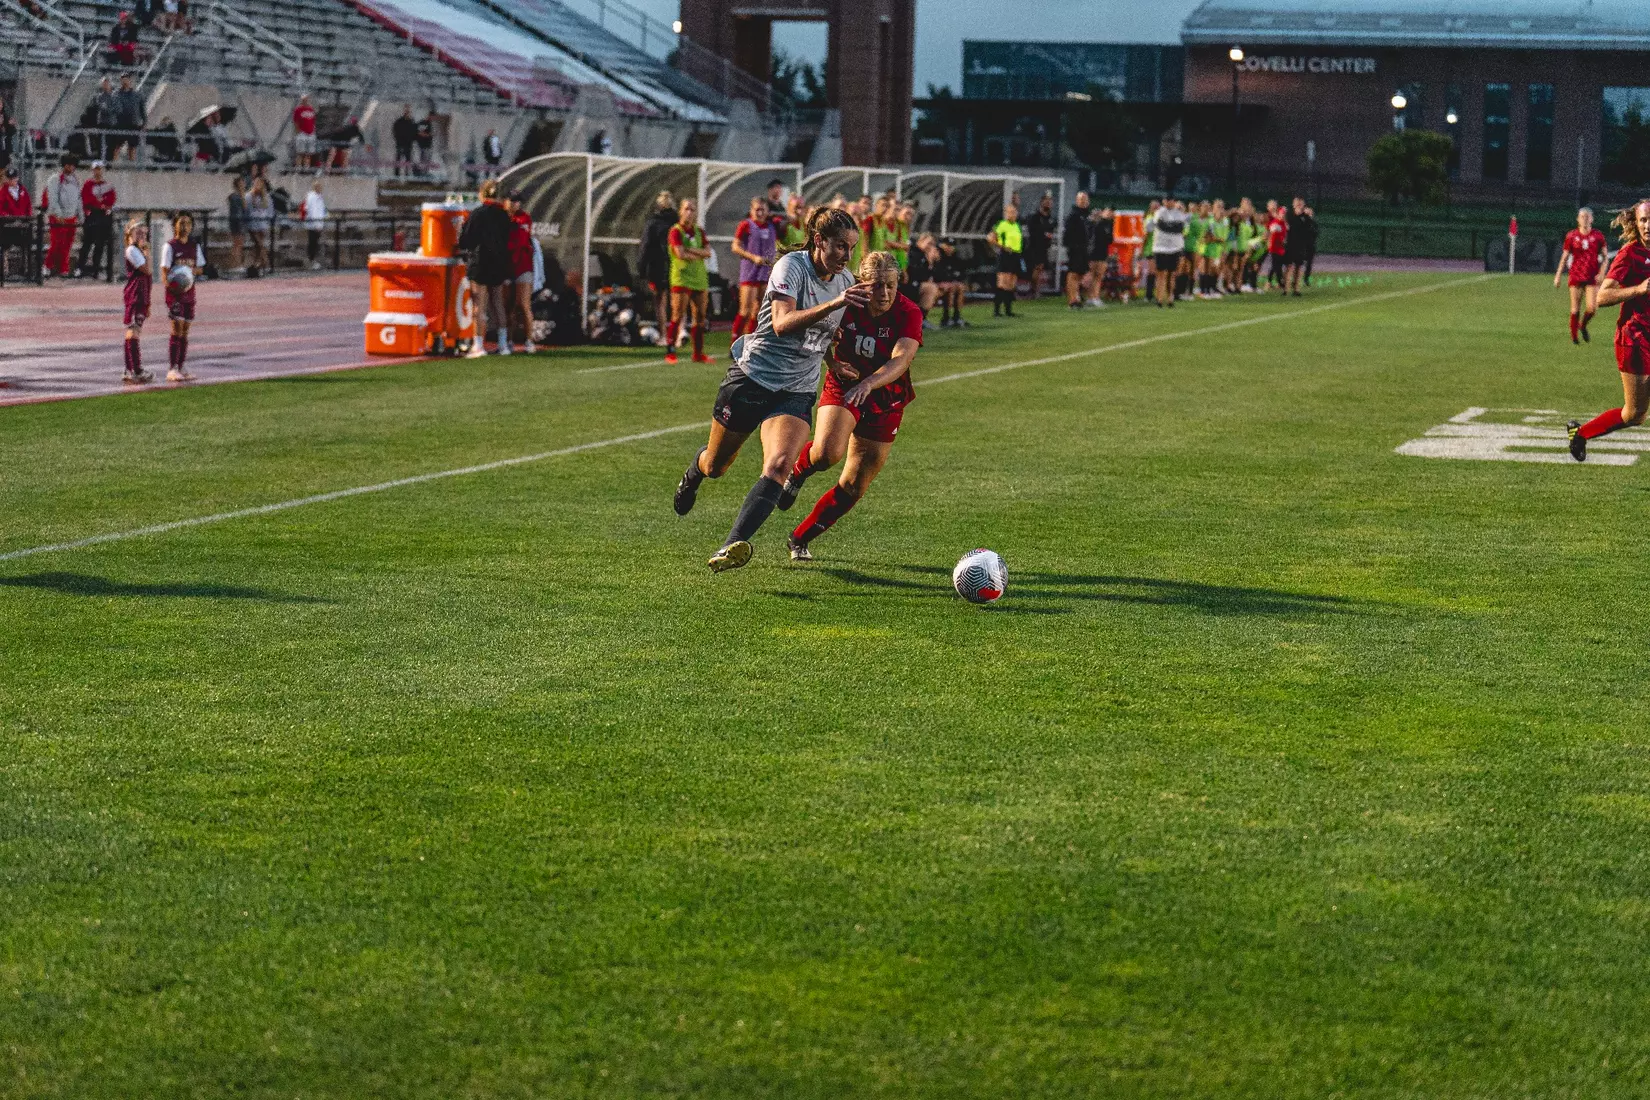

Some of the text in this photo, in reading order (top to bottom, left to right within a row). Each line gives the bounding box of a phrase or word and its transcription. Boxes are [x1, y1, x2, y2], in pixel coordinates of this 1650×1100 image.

[1308, 57, 1376, 73] CENTER
[379, 326, 397, 346] G
[855, 335, 876, 359] 19
